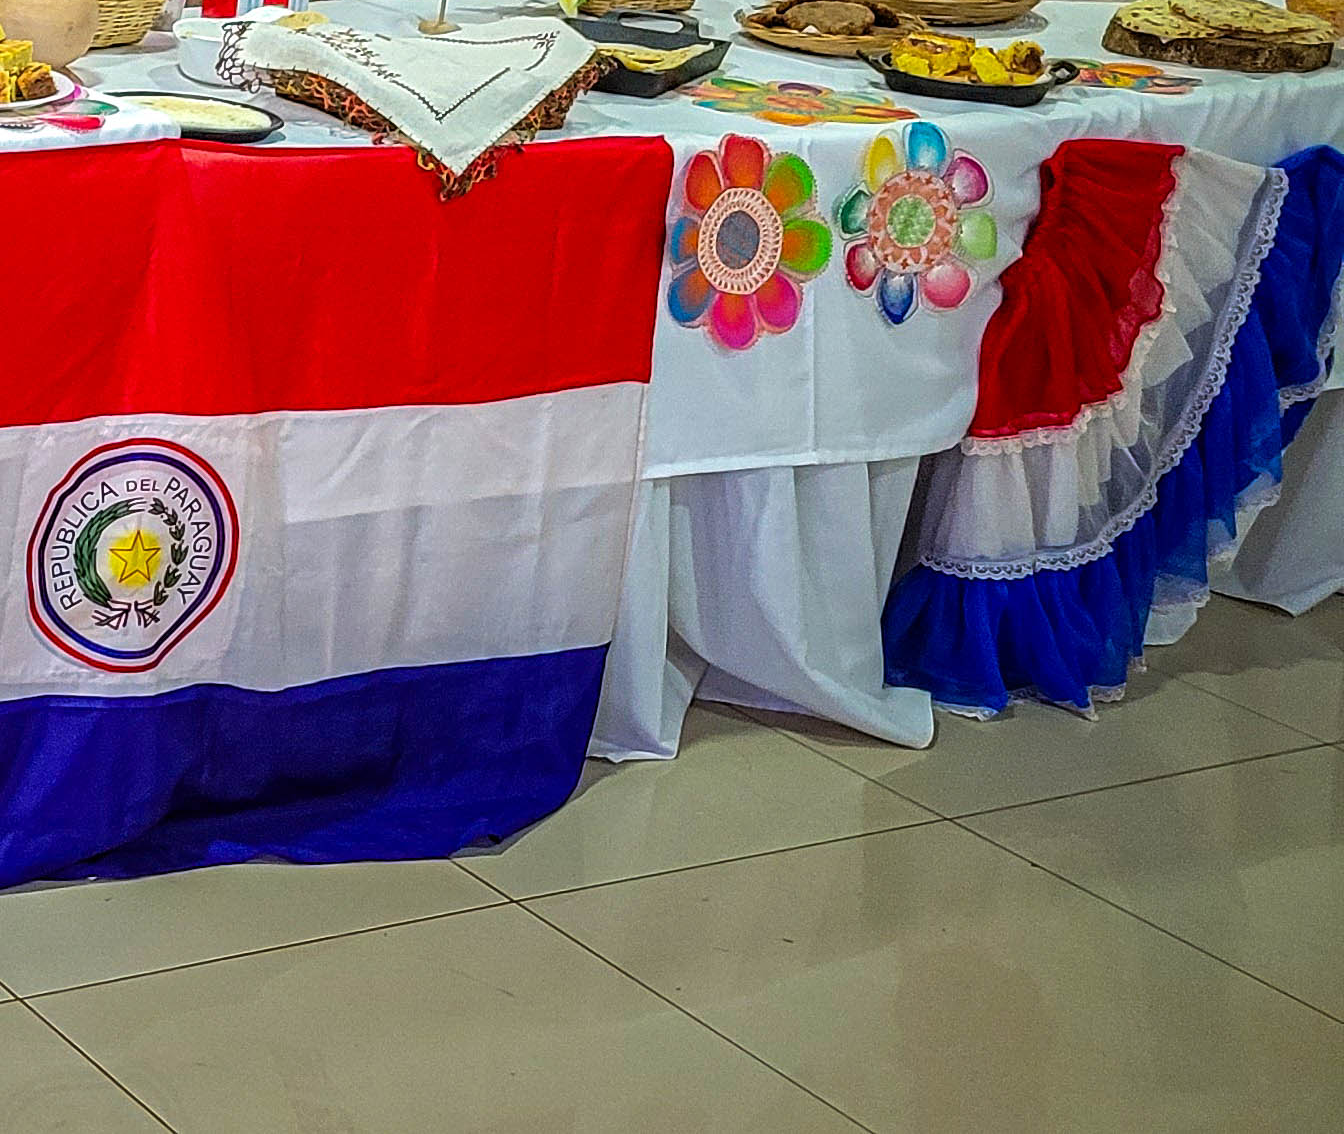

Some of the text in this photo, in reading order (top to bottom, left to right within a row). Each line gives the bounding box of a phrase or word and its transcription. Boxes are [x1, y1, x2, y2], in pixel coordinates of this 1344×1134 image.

[50, 476, 213, 611] REPUBLICA DEL PARAGUAY
